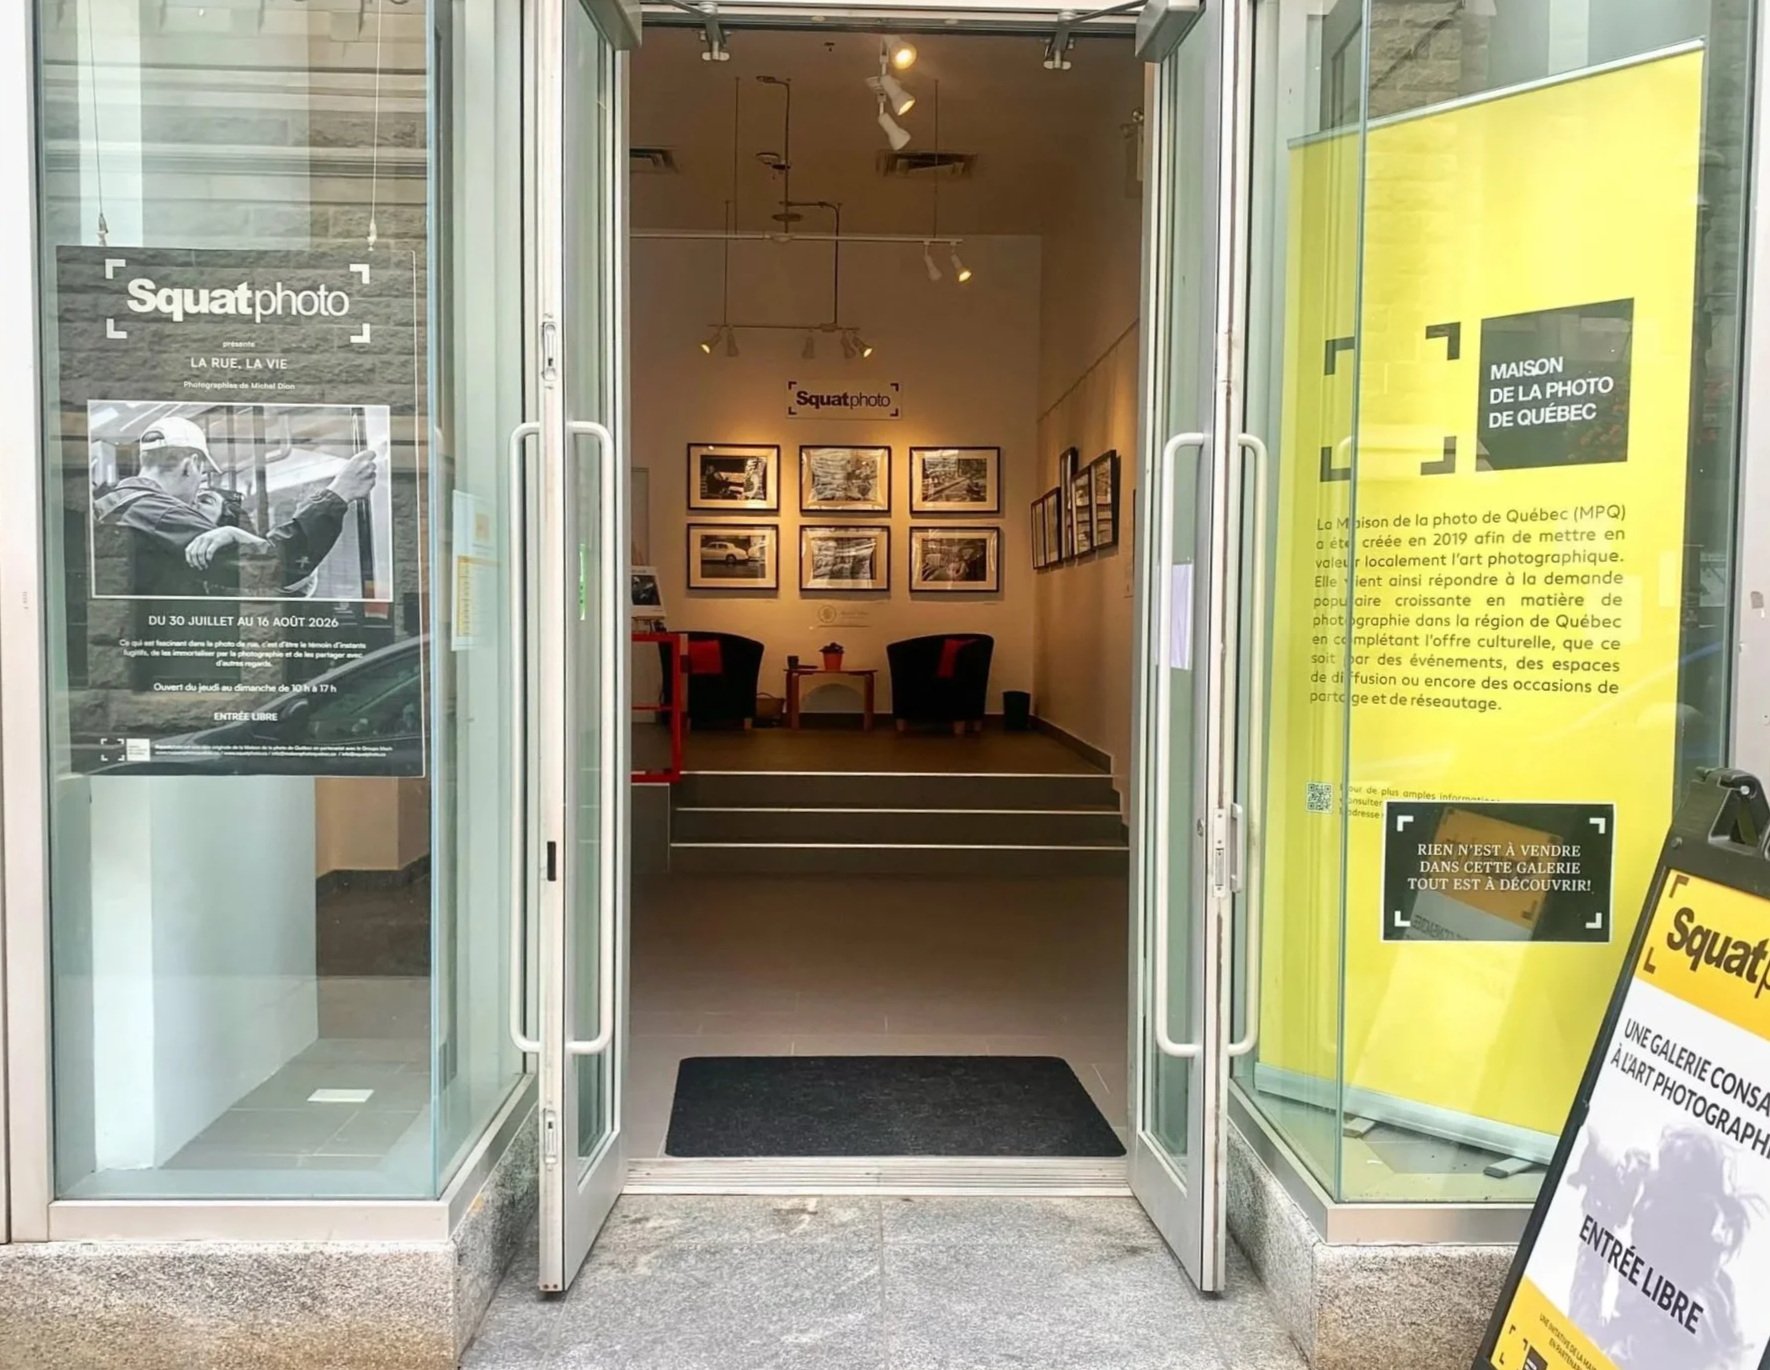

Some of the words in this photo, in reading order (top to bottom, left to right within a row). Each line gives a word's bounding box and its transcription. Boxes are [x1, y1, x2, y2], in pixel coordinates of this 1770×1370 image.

[127, 278, 350, 323] Squatphoto
[191, 358, 207, 368] LA
[211, 358, 241, 369] RUE,
[246, 359, 262, 368] LA
[266, 359, 288, 369] VIE
[1490, 357, 1563, 380] MAISON
[1490, 386, 1514, 405] DE
[1518, 385, 1542, 401] LA
[1546, 376, 1614, 399] PHOTO
[796, 391, 891, 409] Squatphoto
[1488, 412, 1513, 428] DE
[1517, 402, 1597, 426] QUÉBEC
[1317, 519, 1332, 530] La
[1393, 516, 1411, 527] de
[1415, 514, 1428, 527] la
[1433, 513, 1477, 529] photo
[1482, 511, 1501, 524] de
[1506, 507, 1568, 523] Québec
[1573, 505, 1626, 521] (MPQ)
[1316, 539, 1324, 550] a
[1363, 535, 1402, 548] créée
[1408, 536, 1426, 547] en
[1433, 533, 1467, 546] 2019
[1474, 532, 1505, 545] afin
[1512, 531, 1531, 543] de
[1539, 529, 1596, 543] mettre
[1604, 530, 1625, 541] en
[1365, 555, 1446, 568] localement
[1452, 554, 1482, 566] l'art
[1488, 551, 1624, 568] photographique.
[1315, 576, 1337, 588] Elle
[1389, 575, 1422, 586] ainsi
[1429, 573, 1498, 590] répondre
[1505, 572, 1514, 584] à
[1522, 572, 1536, 584] la
[1544, 572, 1623, 585] demande
[1314, 595, 1381, 610] popuaire
[1395, 594, 1471, 607] croissante
[1486, 595, 1505, 606] en
[1521, 593, 1584, 606] matière
[1601, 593, 1622, 606] de
[149, 616, 166, 626] DU
[169, 616, 185, 626] 30
[188, 616, 234, 626] JUILLET
[237, 617, 254, 626] AU
[257, 617, 269, 626] 16
[273, 616, 304, 627] AOÛT
[309, 618, 339, 627] 2026
[1415, 615, 1450, 627] dans
[1456, 615, 1469, 627] la
[1475, 615, 1524, 630] région
[1530, 615, 1549, 628] de
[1555, 614, 1622, 628] Québec
[1312, 636, 1327, 645] en
[1426, 634, 1470, 647] l'offre
[1477, 635, 1555, 651] culturelle,
[1563, 638, 1594, 653] que
[1600, 638, 1620, 650] ce
[1311, 653, 1335, 665] soit
[1377, 653, 1402, 666] des
[1410, 654, 1507, 671] événements,
[1516, 656, 1543, 670] des
[1552, 659, 1620, 674] espaces
[153, 682, 183, 691] Ouvert
[185, 683, 197, 691] du
[198, 683, 220, 693] jeudi
[234, 683, 276, 692] dimanche
[278, 683, 289, 692] de
[292, 684, 301, 692] 10
[320, 684, 329, 692] 17
[331, 684, 337, 692] h
[1311, 671, 1327, 683] de
[1402, 676, 1419, 686] ou
[1424, 676, 1476, 689] encore
[1481, 677, 1508, 690] des
[1513, 678, 1591, 693] occasions
[1598, 681, 1619, 694] de
[1371, 694, 1386, 705] et
[1390, 693, 1407, 706] de
[1411, 694, 1501, 713] réseautage.
[214, 711, 249, 721] ENTRÉE
[251, 712, 278, 721] LIBRE
[1340, 784, 1362, 794] our
[1366, 785, 1378, 795] de
[1381, 786, 1399, 797] plus
[1403, 790, 1436, 800] amples
[1417, 844, 1453, 856] RIEN
[1458, 844, 1501, 857] N'EST
[1505, 842, 1516, 857] À
[1520, 845, 1581, 857] VENDRE
[1420, 861, 1459, 873] DANS
[1464, 862, 1512, 874] CETTE
[1517, 862, 1580, 874] GALERIE
[1408, 877, 1447, 890] TOUT
[1453, 879, 1482, 891] EST
[1485, 877, 1495, 891] À
[1500, 876, 1591, 892] DÉCOUVRIR!
[1624, 1018, 1652, 1049] UNE
[1650, 1034, 1711, 1082] GALERIE
[1610, 1043, 1622, 1068] À
[1621, 1052, 1656, 1086] L'ART
[1579, 1214, 1645, 1287] ENTRÉE
[1641, 1267, 1704, 1334] LIBRE
